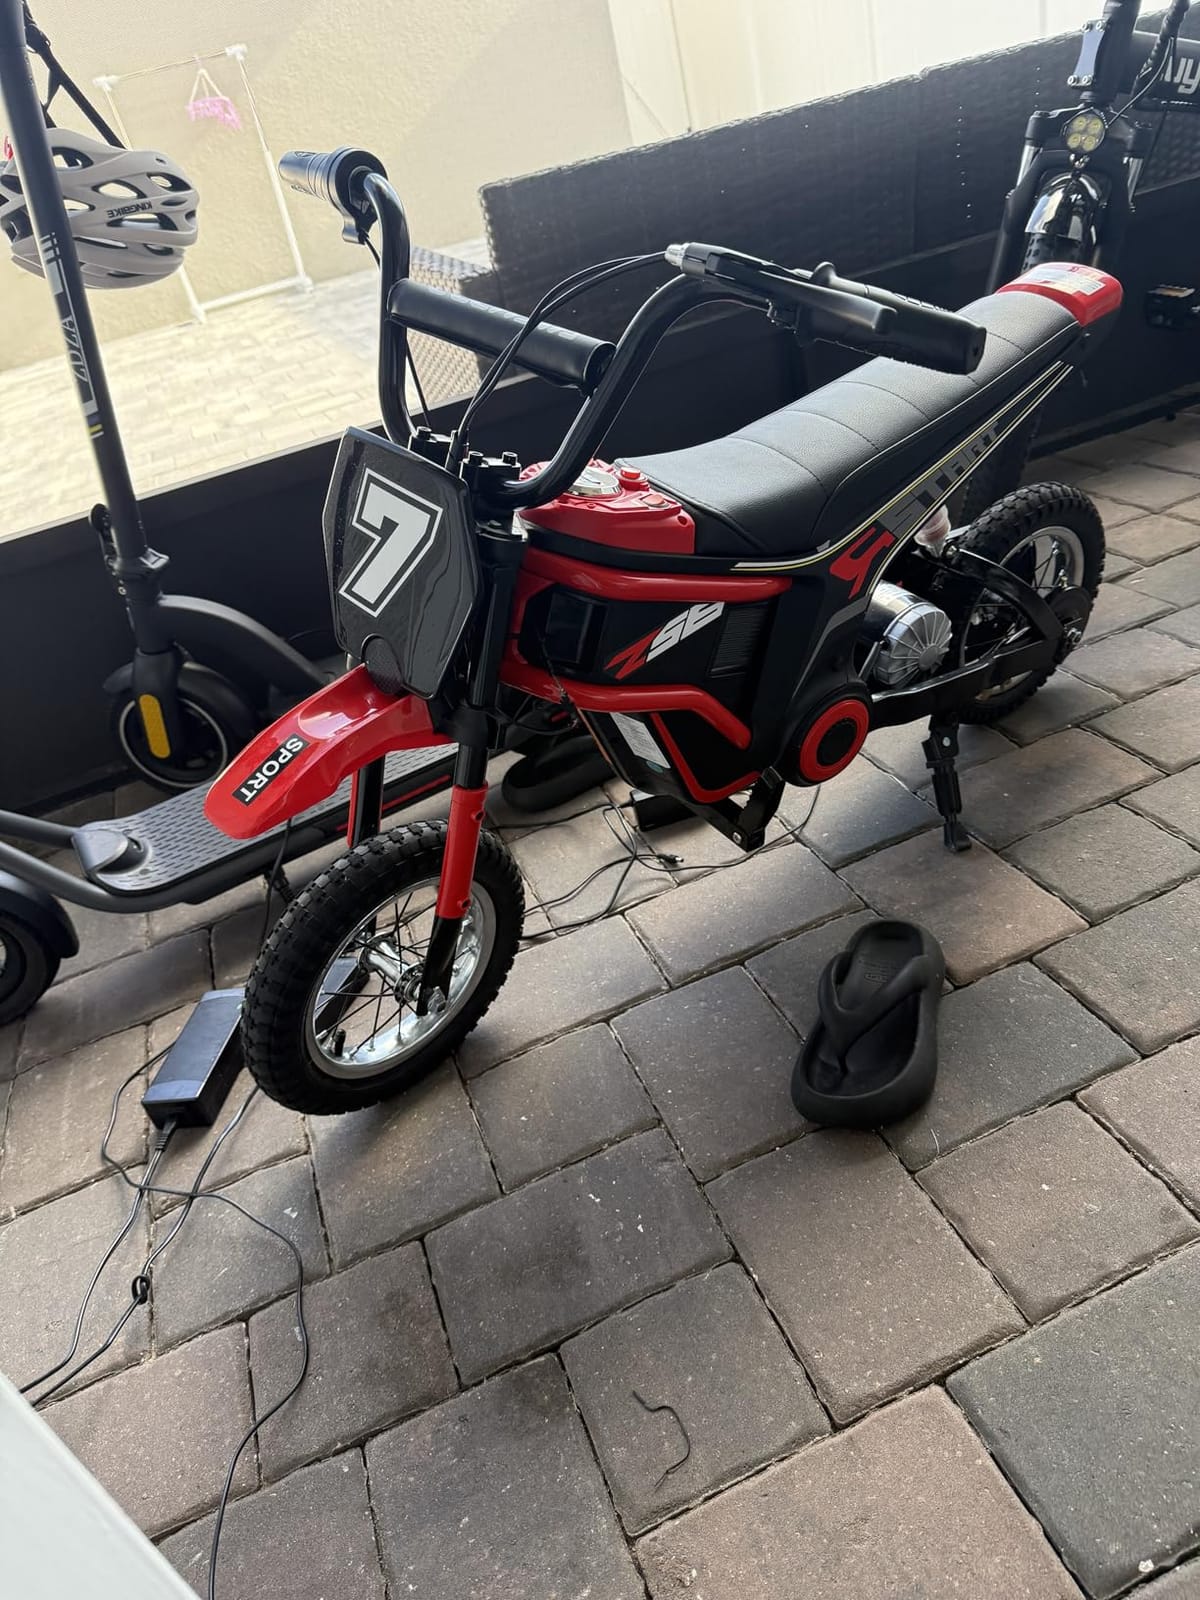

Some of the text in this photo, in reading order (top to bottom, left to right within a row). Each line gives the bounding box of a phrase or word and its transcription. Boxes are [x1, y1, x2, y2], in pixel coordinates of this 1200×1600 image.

[106, 200, 153, 218] KINGBIKE
[339, 468, 443, 618] 7
[240, 737, 303, 802] SPORT
